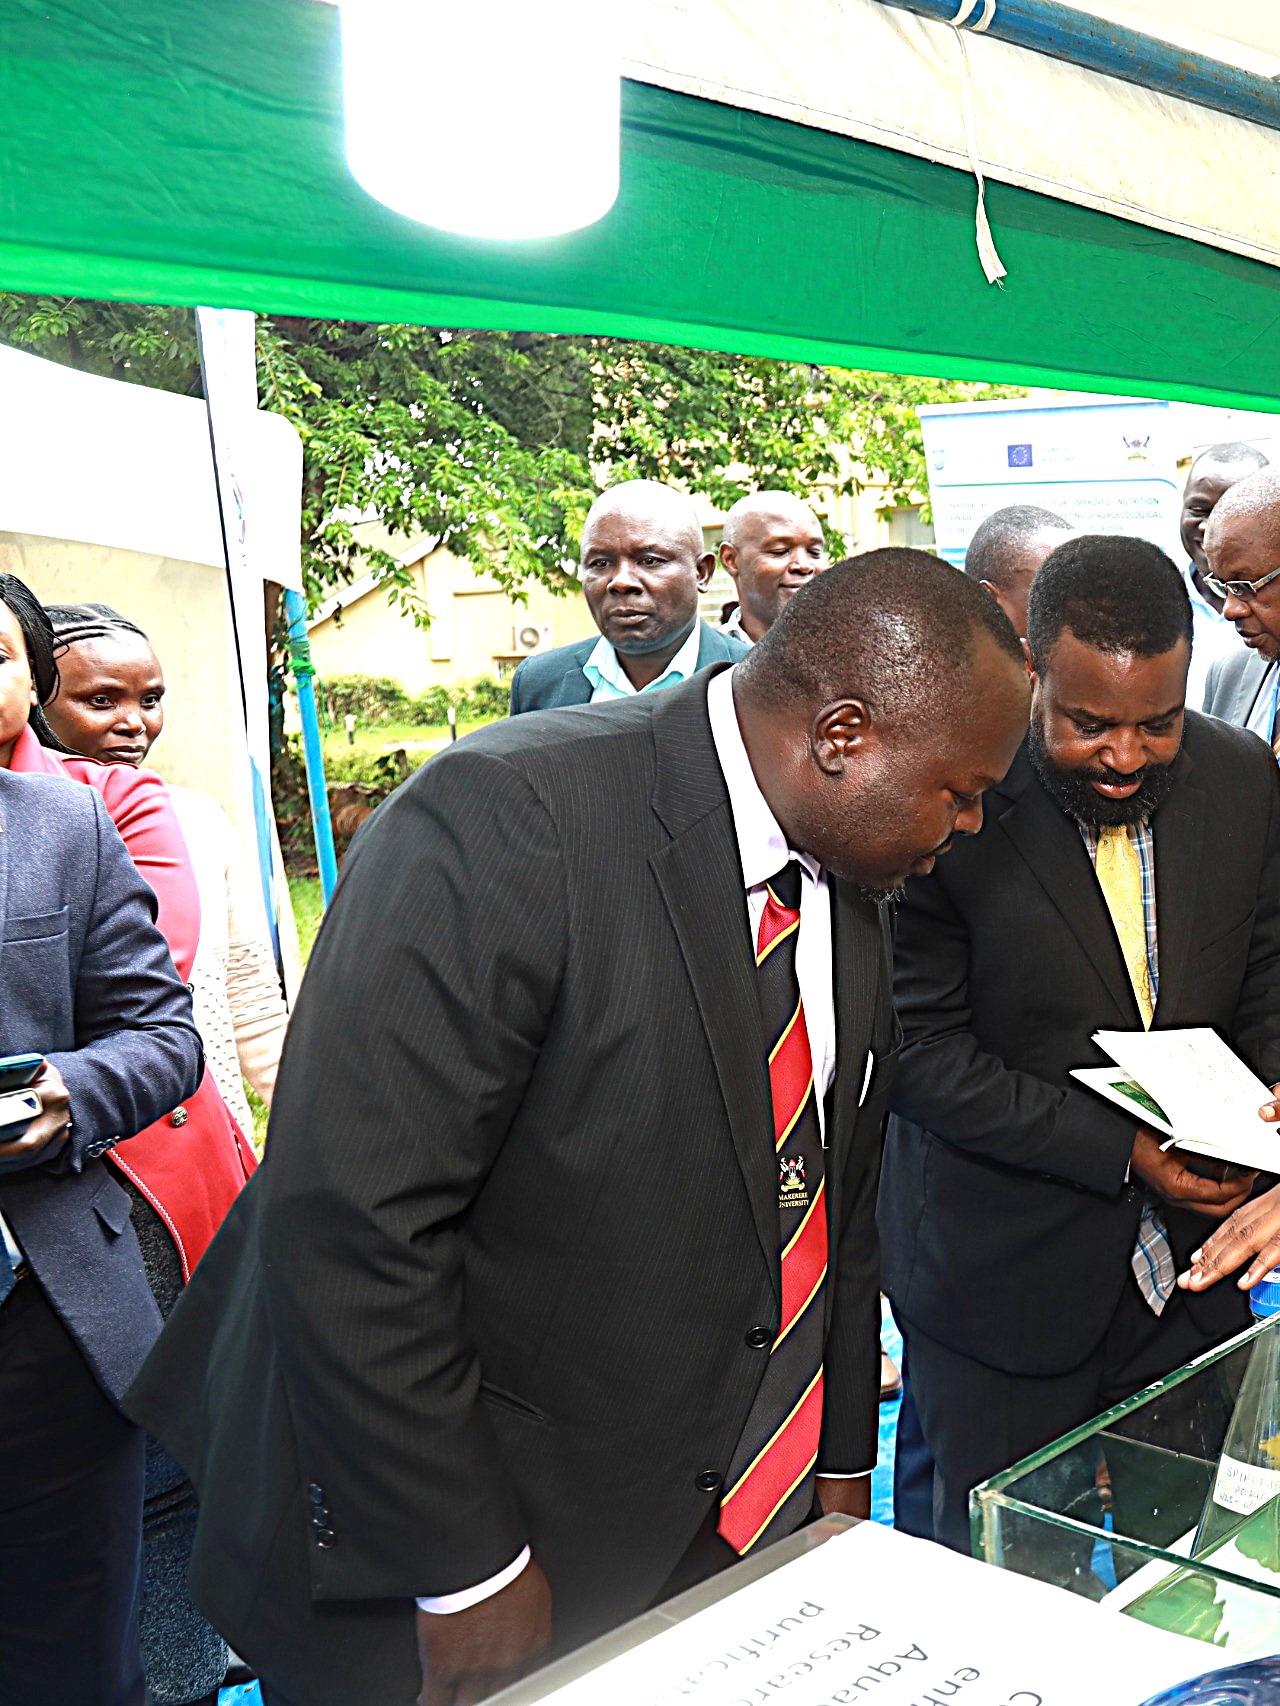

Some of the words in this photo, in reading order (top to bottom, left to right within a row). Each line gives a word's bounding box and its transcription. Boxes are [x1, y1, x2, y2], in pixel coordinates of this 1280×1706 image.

[1118, 496, 1160, 505] NUTRITION
[655, 1600, 826, 1702] purificat
[731, 1623, 882, 1706] Researc
[817, 1643, 929, 1706] Aqua
